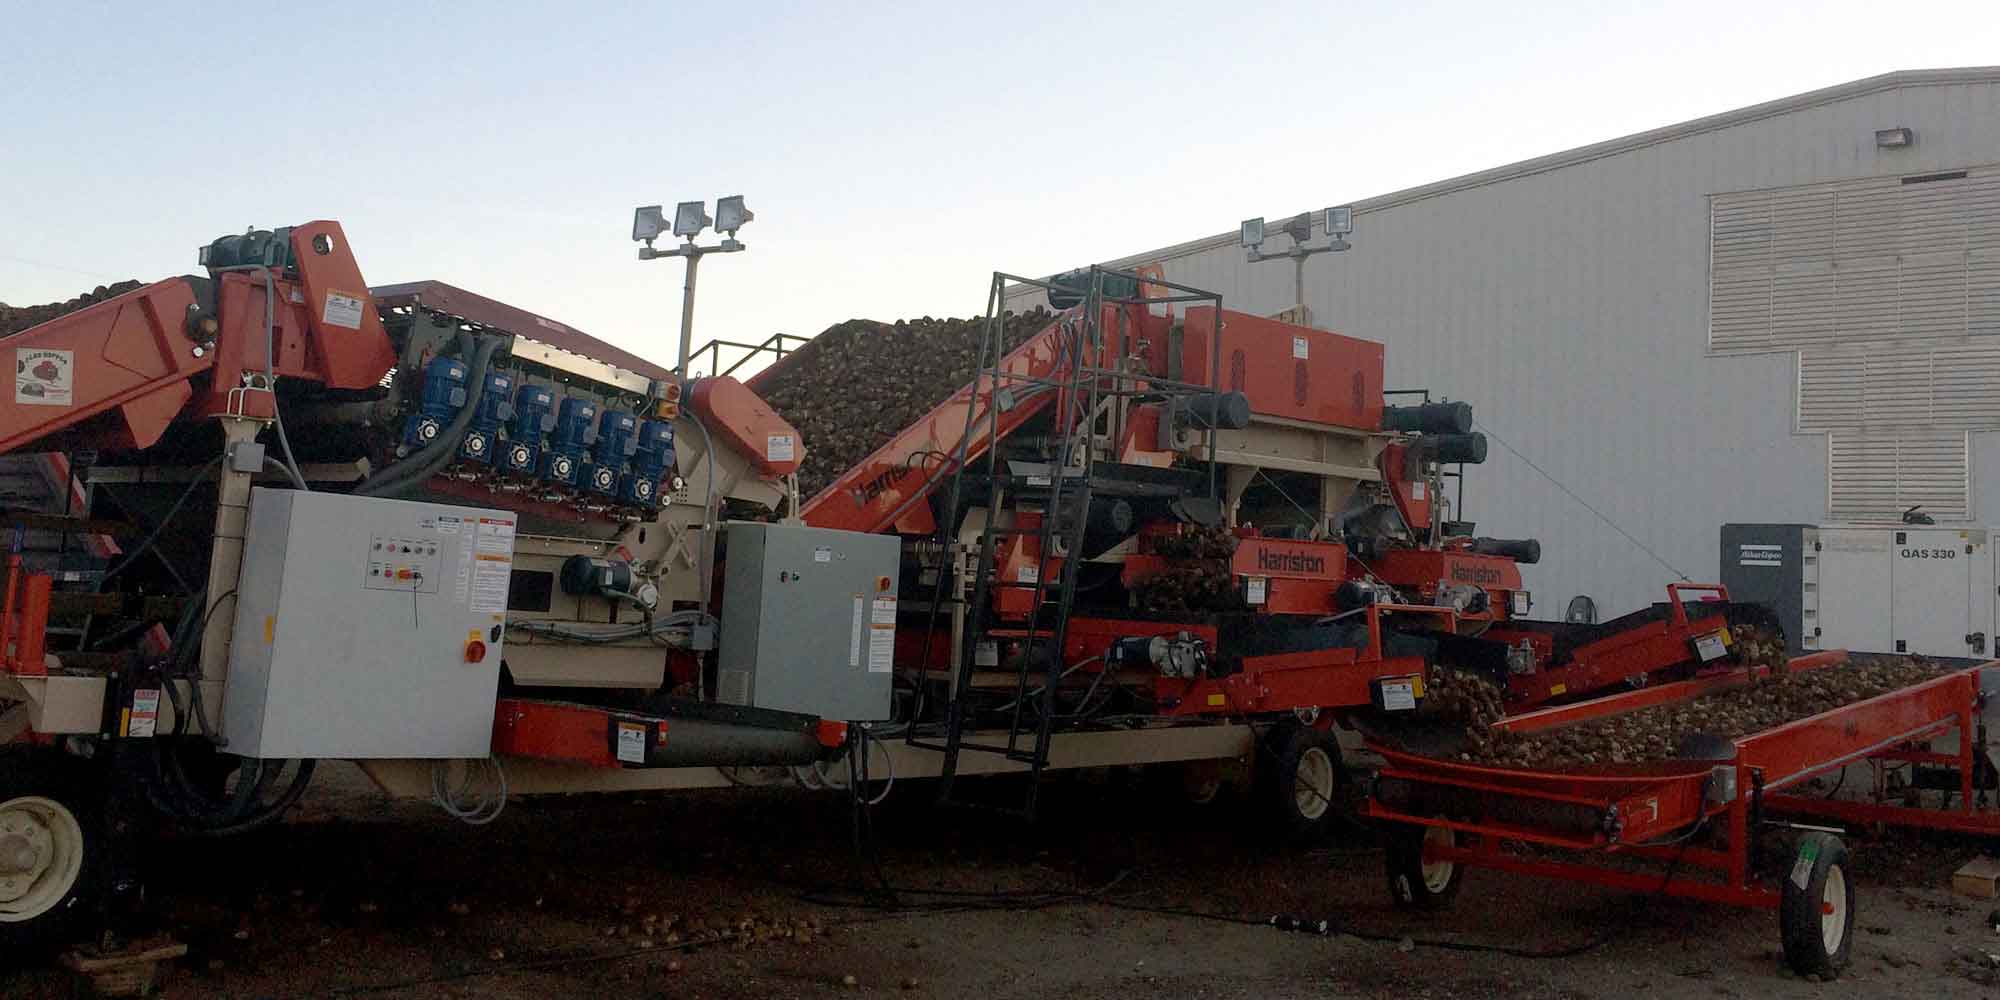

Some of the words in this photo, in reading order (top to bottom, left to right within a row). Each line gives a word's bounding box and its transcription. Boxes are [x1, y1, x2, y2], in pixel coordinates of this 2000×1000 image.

[1258, 547, 1325, 574] Harriston
[1901, 549, 1929, 559] QAS
[1931, 549, 1955, 559] 330
